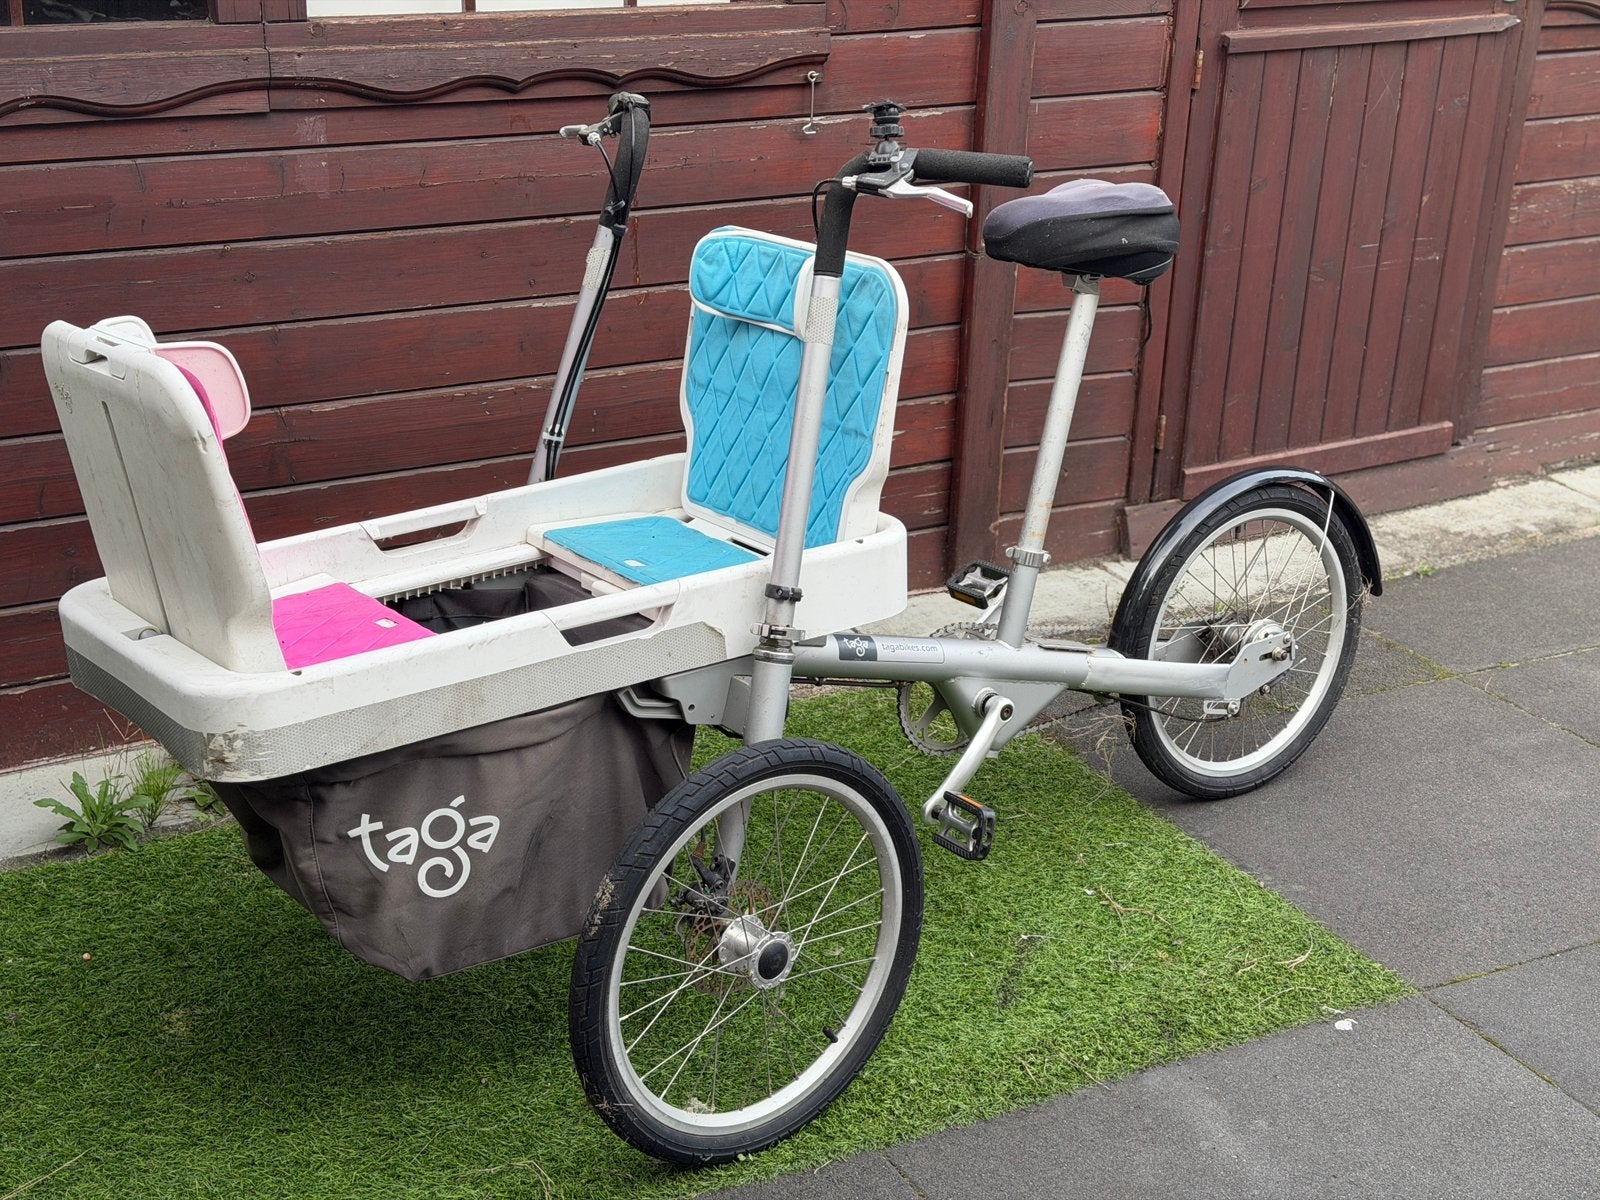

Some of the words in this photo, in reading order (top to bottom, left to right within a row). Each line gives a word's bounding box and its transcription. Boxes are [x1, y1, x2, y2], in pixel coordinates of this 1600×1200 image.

[843, 636, 869, 657] taga
[881, 642, 938, 653] tagabikes.com
[347, 794, 500, 898] taga
